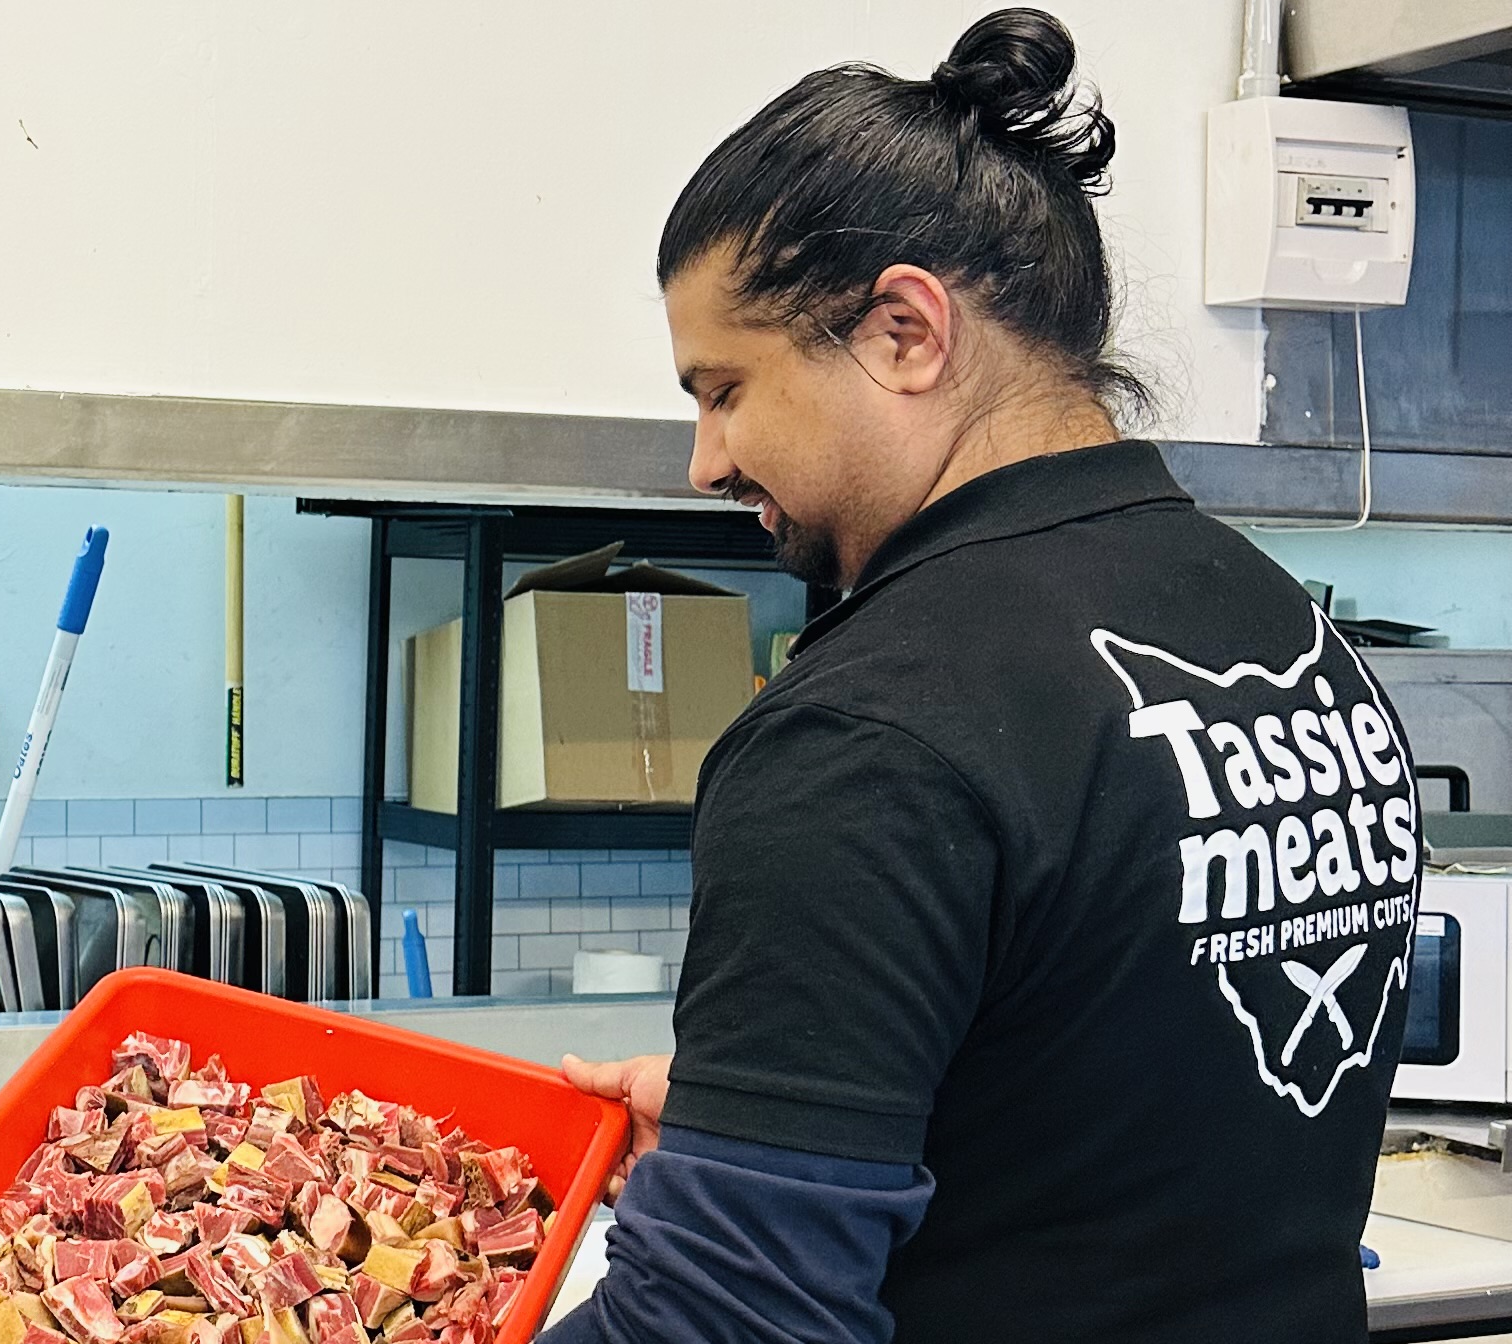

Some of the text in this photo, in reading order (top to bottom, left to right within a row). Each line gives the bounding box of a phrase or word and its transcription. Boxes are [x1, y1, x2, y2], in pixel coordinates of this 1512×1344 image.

[1128, 674, 1401, 819] Tassie
[1177, 792, 1417, 924] meats
[1190, 893, 1411, 966] FRESH PREMIUM CUTS
